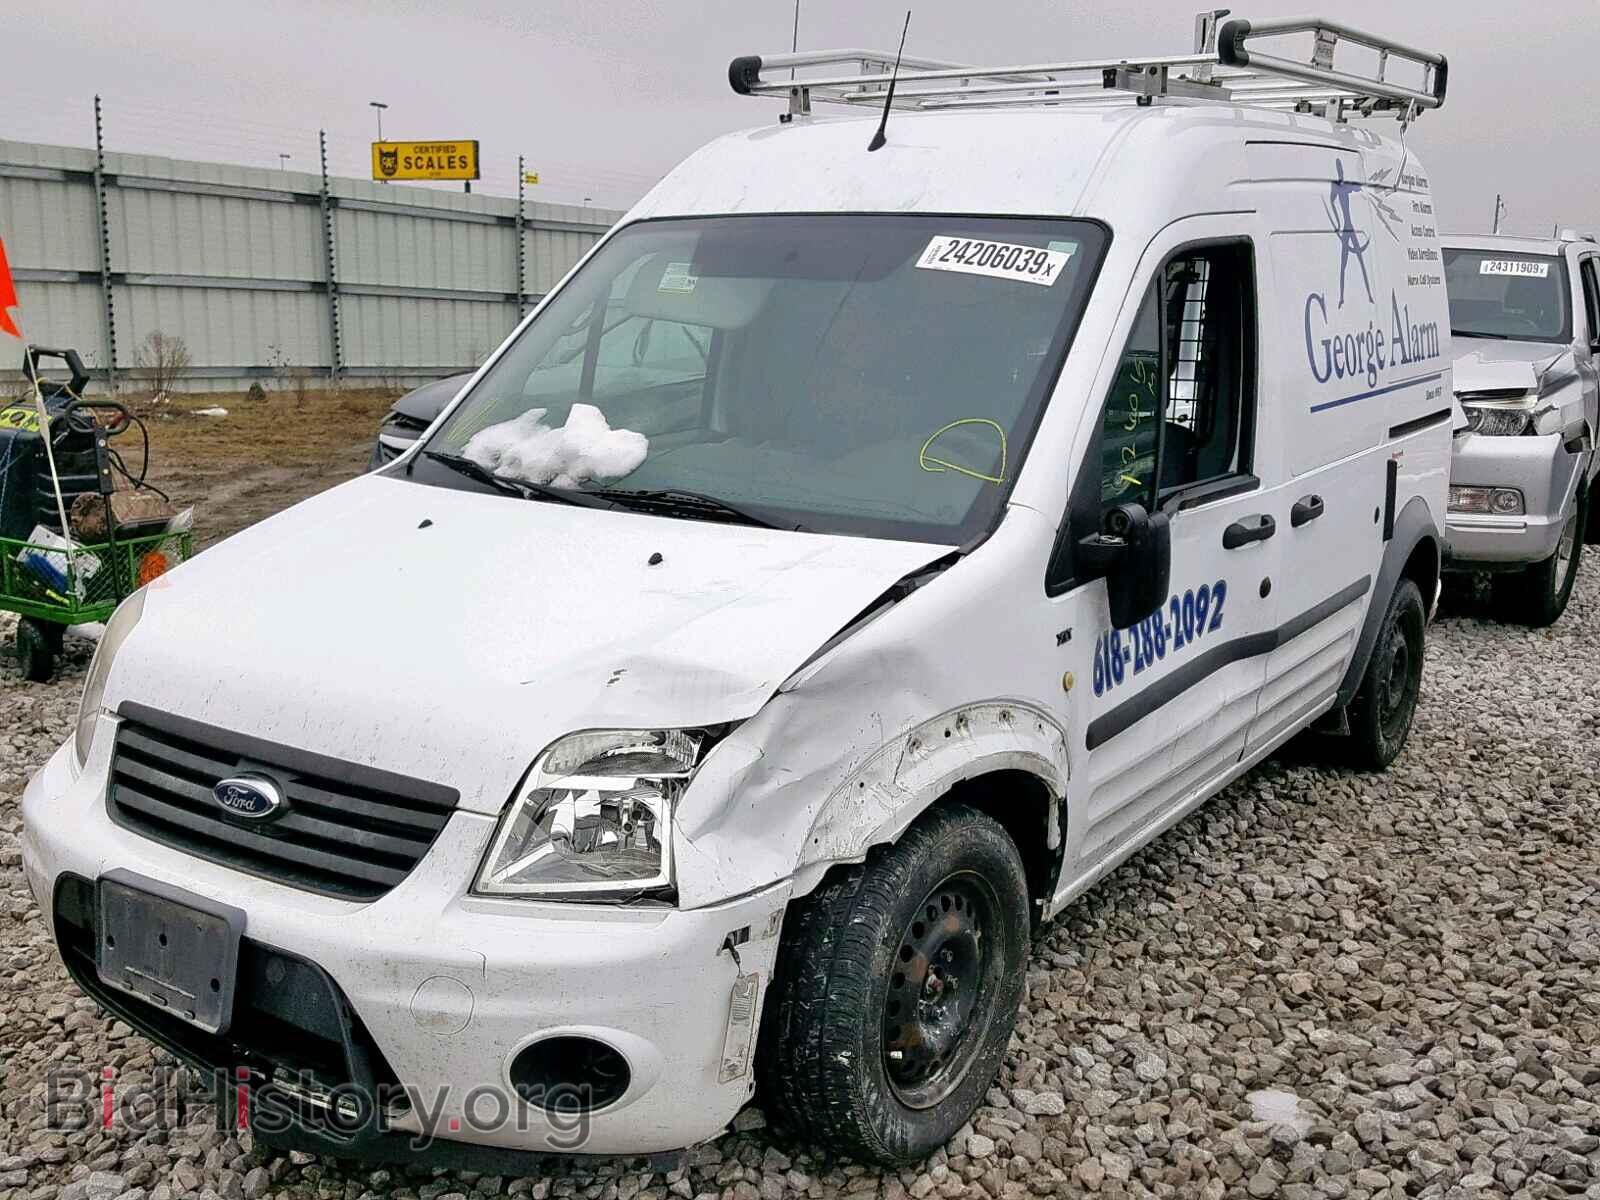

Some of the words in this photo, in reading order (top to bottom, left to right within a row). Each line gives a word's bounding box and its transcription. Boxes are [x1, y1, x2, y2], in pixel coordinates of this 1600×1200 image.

[414, 145, 456, 154] CERTIFIED
[403, 155, 468, 170] SCALES
[1304, 292, 1386, 389] George
[1390, 288, 1440, 367] Alarm
[1092, 579, 1227, 698] 618-288-2092
[223, 786, 257, 811] Ford
